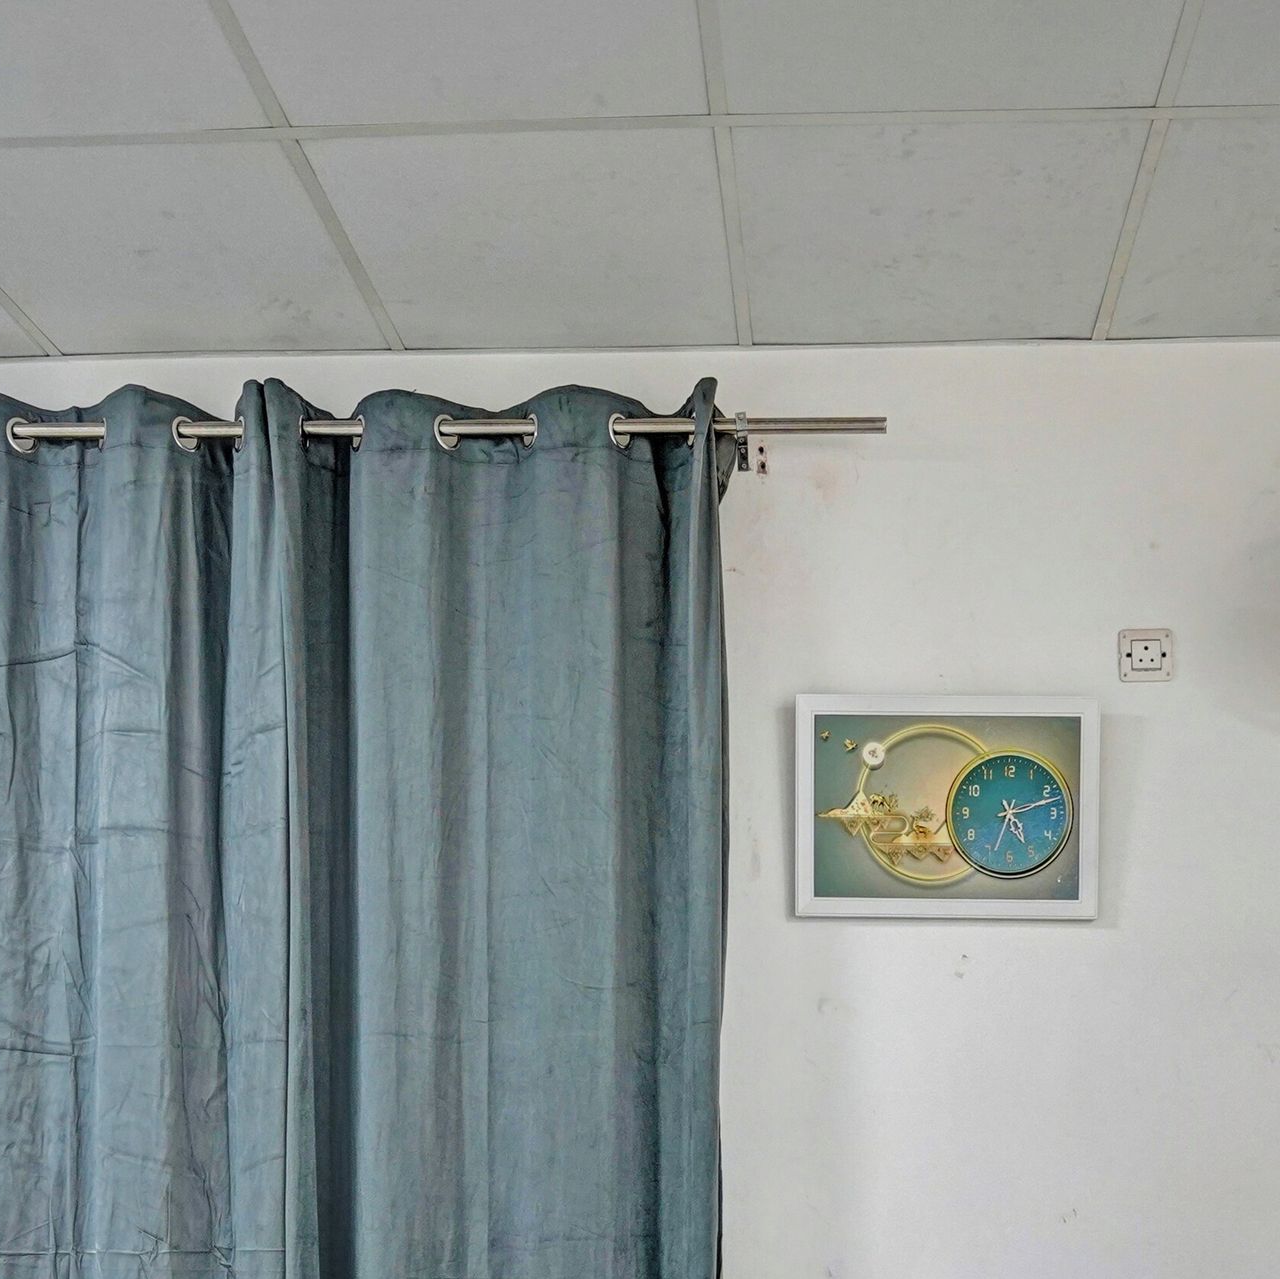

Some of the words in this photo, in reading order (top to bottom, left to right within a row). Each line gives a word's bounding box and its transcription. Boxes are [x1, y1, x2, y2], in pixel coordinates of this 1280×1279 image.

[983, 769, 993, 780] 11
[1004, 765, 1016, 778] 12
[968, 784, 980, 797] 10
[1042, 785, 1051, 797] 2
[962, 807, 970, 819] 9
[1050, 807, 1057, 820] 3
[967, 828, 976, 841] 8
[1044, 830, 1052, 840] 4
[1006, 851, 1014, 863] 6
